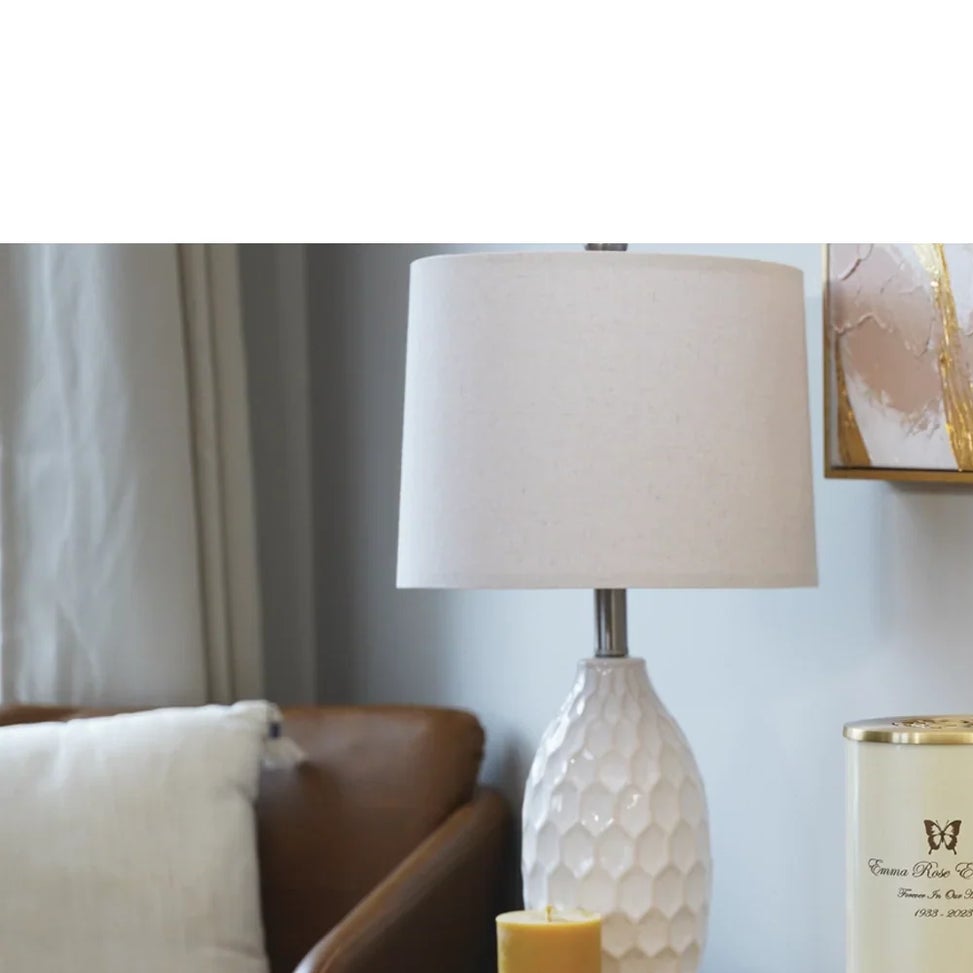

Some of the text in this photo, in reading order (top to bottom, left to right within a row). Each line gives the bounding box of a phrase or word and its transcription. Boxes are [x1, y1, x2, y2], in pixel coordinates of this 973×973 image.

[868, 858, 908, 876] Emma
[912, 860, 950, 879] Rose
[897, 887, 926, 898] Forever
[927, 889, 941, 899] In
[945, 889, 962, 900] Our
[946, 908, 973, 918] 2023
